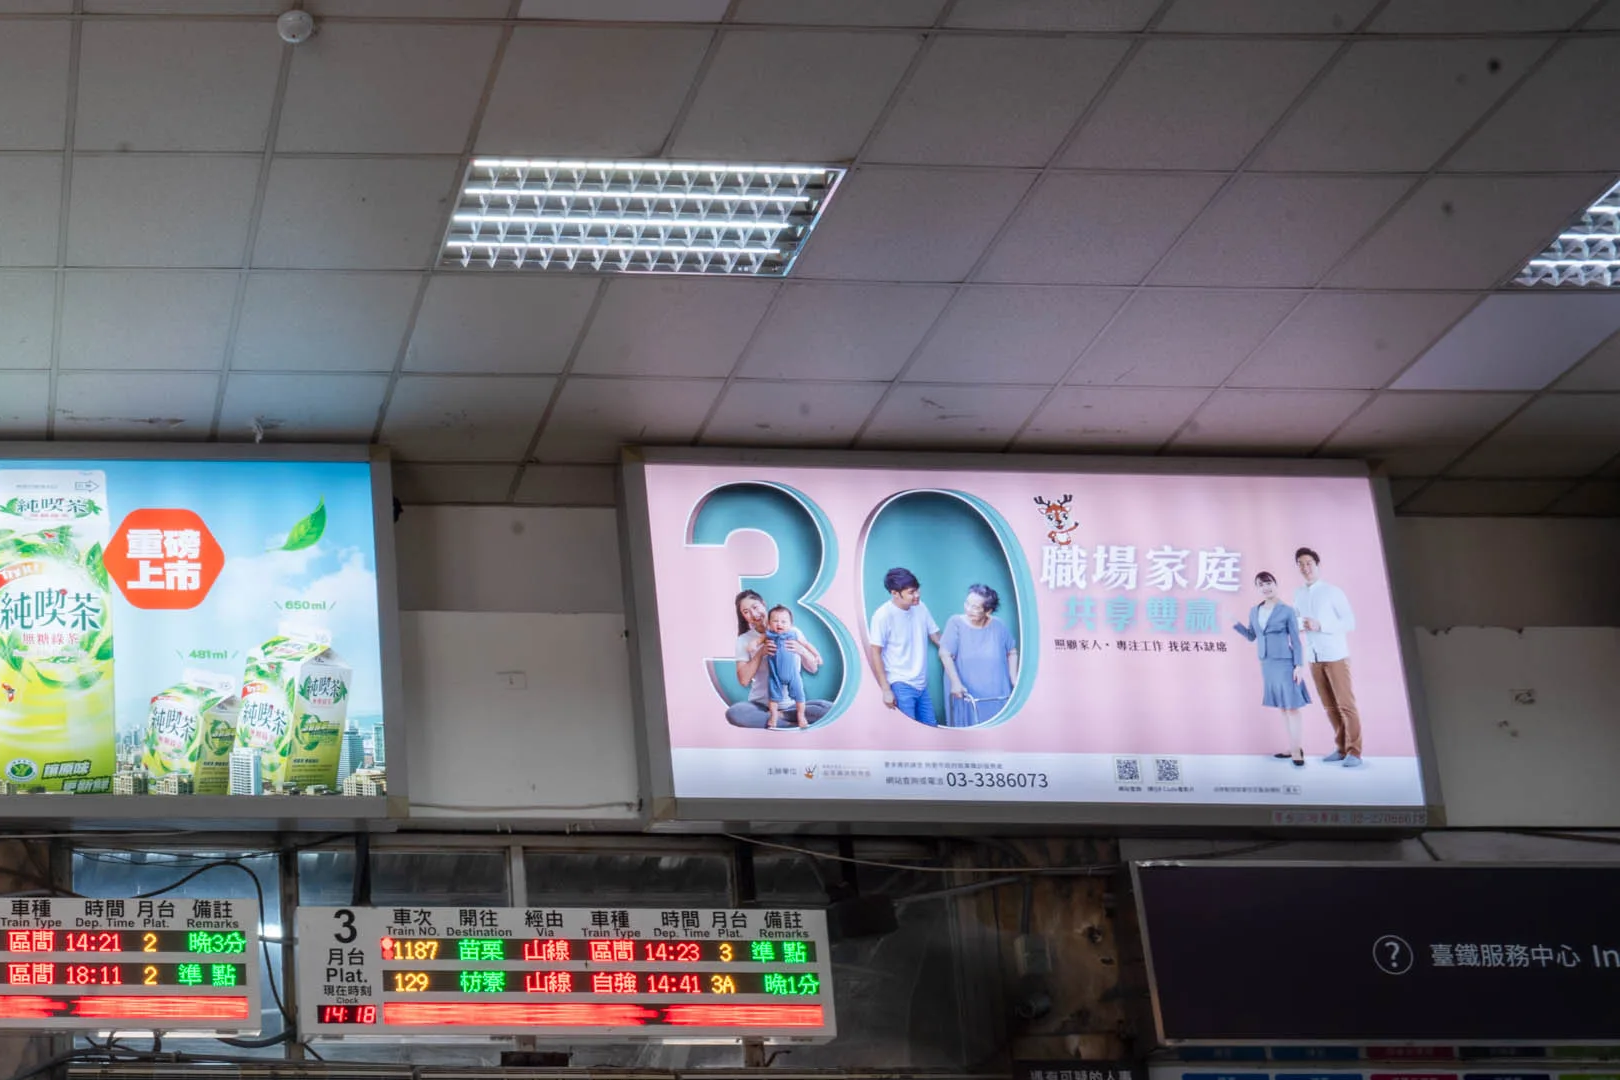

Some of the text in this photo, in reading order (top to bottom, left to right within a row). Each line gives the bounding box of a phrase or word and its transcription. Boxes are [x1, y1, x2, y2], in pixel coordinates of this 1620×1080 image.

[17, 498, 89, 513] 純喫茶
[126, 529, 201, 559] 重磅
[126, 560, 202, 590] 上市
[1039, 545, 1243, 592] 職場家庭
[0, 587, 101, 631] 純喫茶
[285, 600, 326, 610] 650ml
[685, 481, 1040, 730] 30
[189, 649, 228, 659] 481ml
[946, 772, 1049, 788] 03-3386073
[11, 899, 52, 918] 車種
[85, 899, 125, 918] 時間
[136, 900, 176, 918] 月台
[192, 900, 233, 918] 備註
[0, 918, 30, 927] Train
[33, 918, 62, 930] Type
[75, 918, 102, 930] Dep.
[106, 918, 135, 928] Time
[143, 918, 169, 928] Plat.
[186, 918, 239, 928] Remarks
[333, 909, 358, 944] 3
[392, 909, 803, 929] 車次 開往 經由 車種 時間 月台 備註
[7, 930, 54, 953] 區間
[66, 933, 122, 952] 14:21
[143, 933, 157, 952] 2
[188, 931, 247, 954] 晚3分
[386, 926, 513, 938] Train Destination
[327, 948, 365, 966] 月台
[393, 938, 733, 962] 1187 苗栗 山線 區間 14:23 3
[1430, 943, 1581, 968] 臺鐵服務中心
[7, 963, 54, 985] 區間
[66, 965, 122, 985] 18:11
[143, 965, 157, 985] 2
[326, 968, 369, 983] Plat.
[394, 970, 820, 995] 129 枋寮 山線 自強 14:41 3A 晚1分
[323, 985, 372, 996] 現在時刻
[323, 1006, 376, 1023] 14:18
